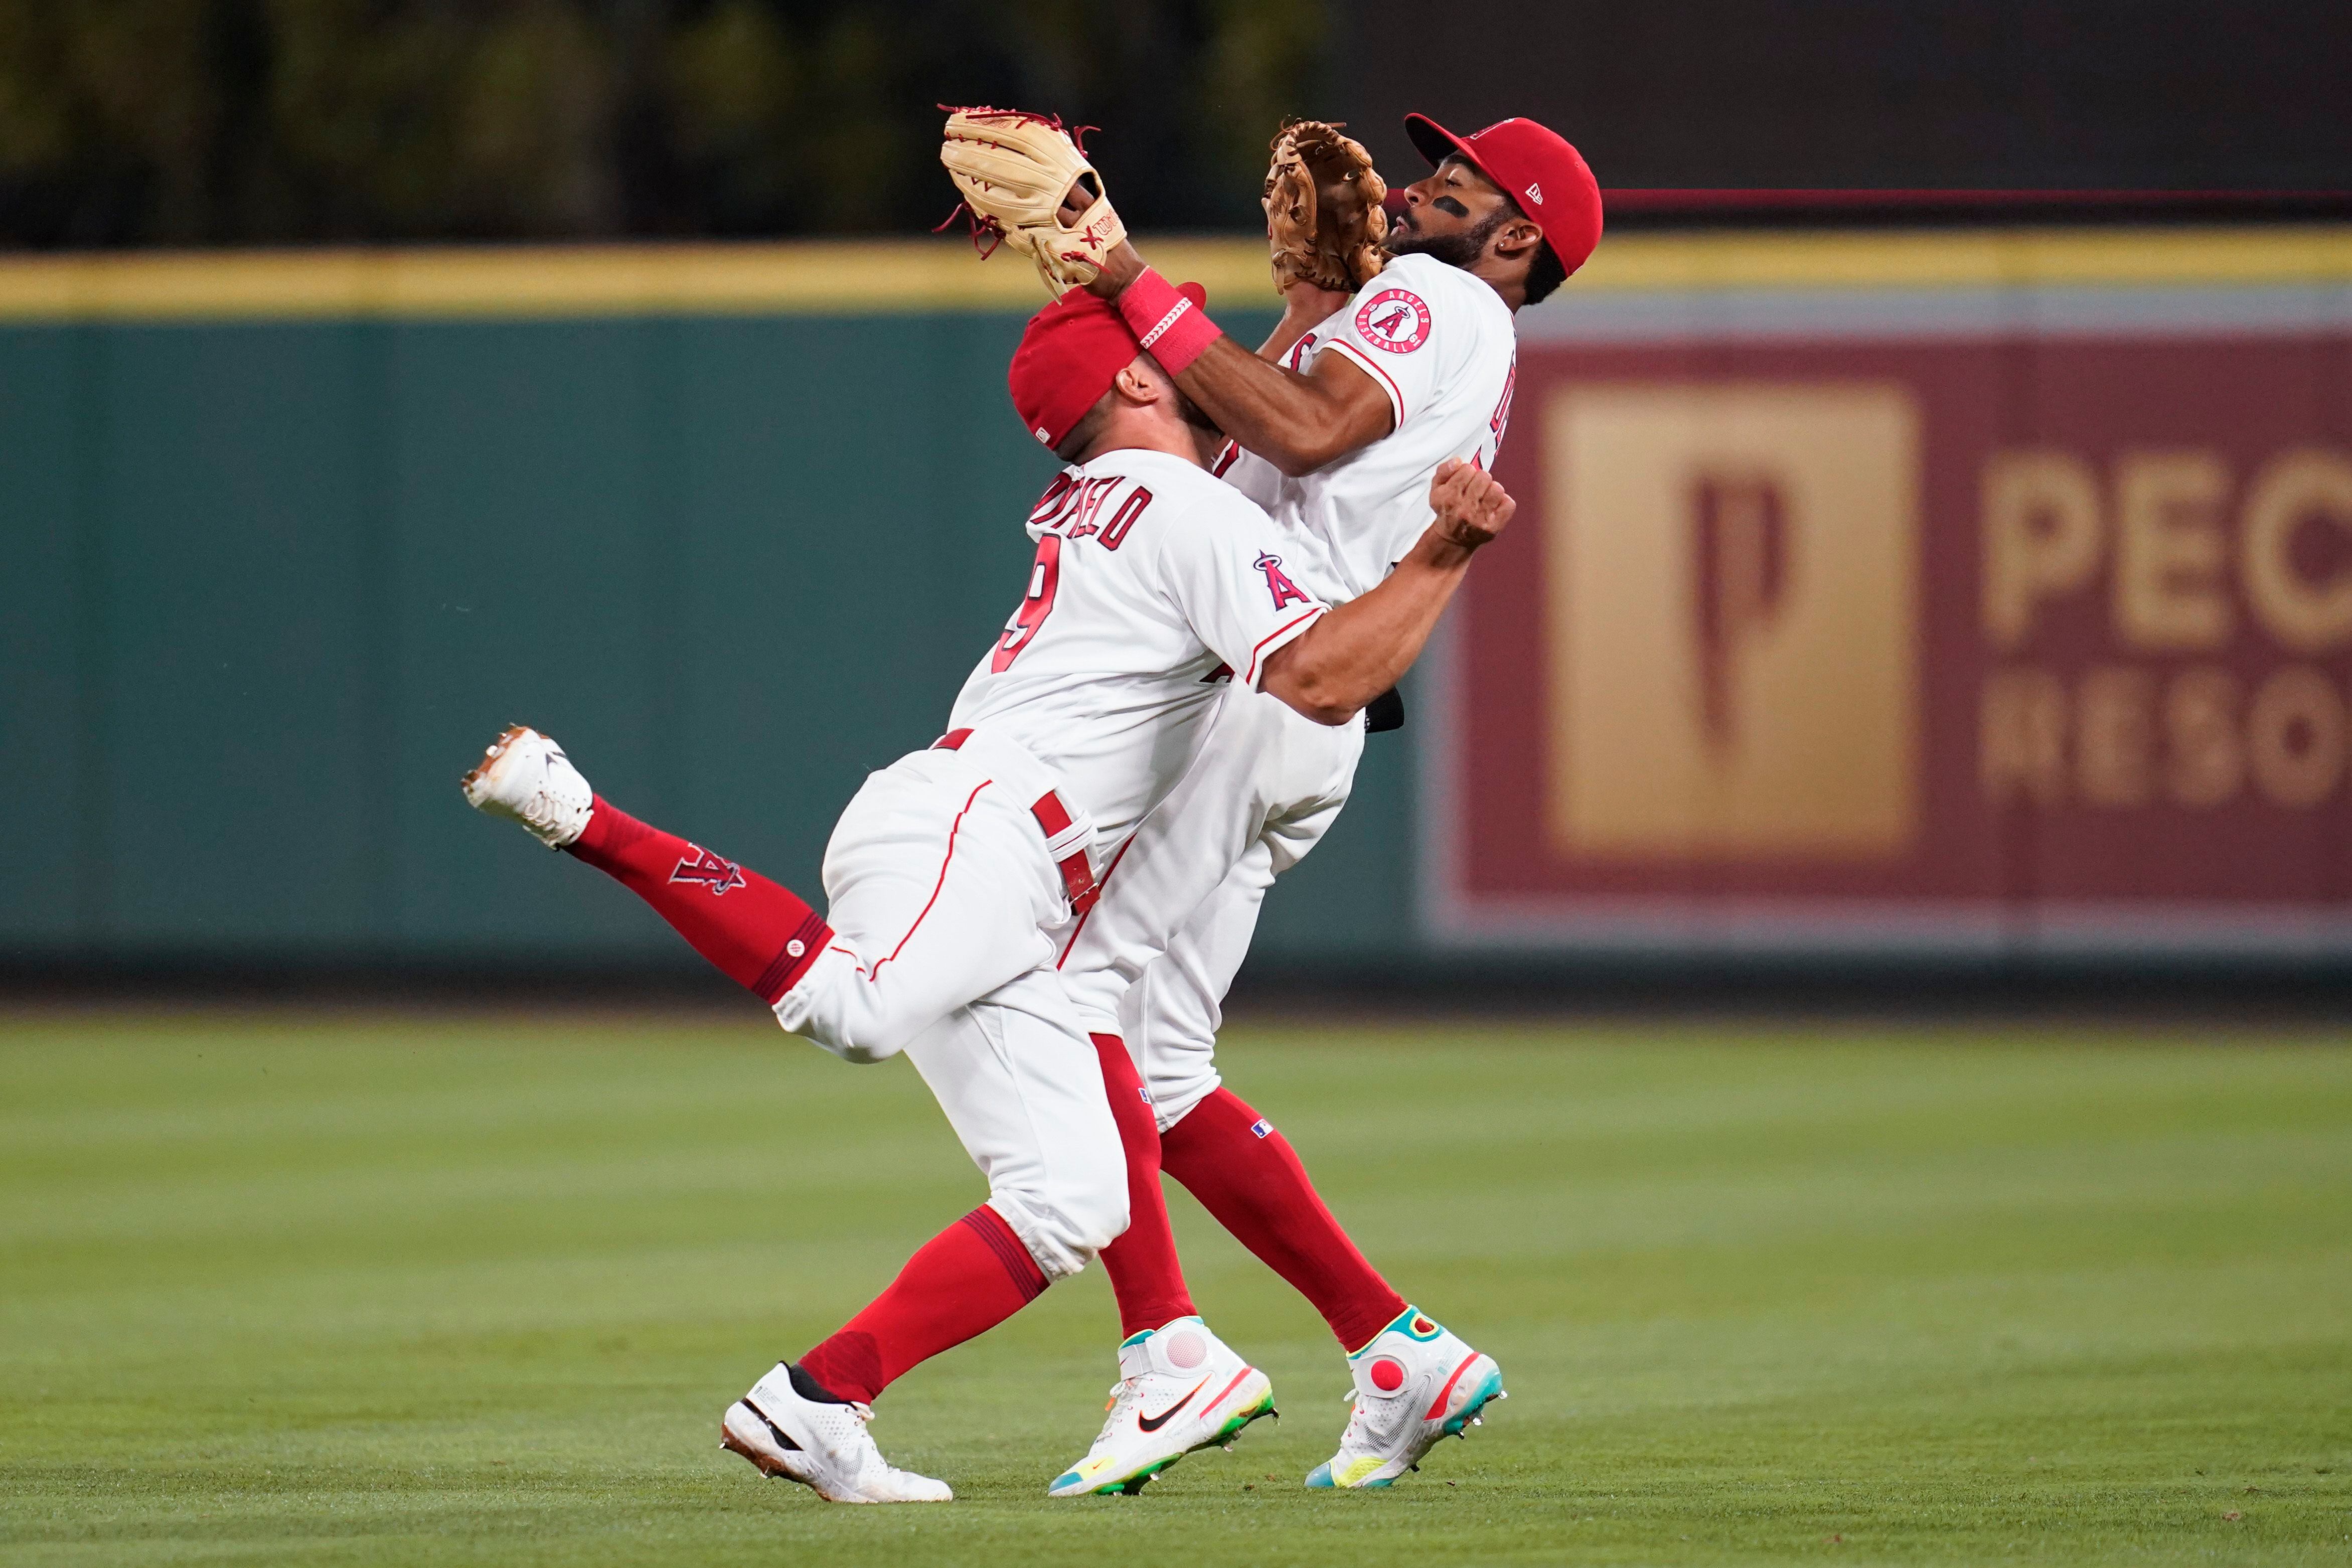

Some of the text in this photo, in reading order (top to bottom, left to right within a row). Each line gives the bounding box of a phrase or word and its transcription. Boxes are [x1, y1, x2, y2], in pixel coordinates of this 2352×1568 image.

[1389, 290, 1430, 323] ANGELS
[1357, 315, 1407, 352] BASEBALL
[1408, 334, 1422, 347] 61
[991, 533, 1061, 675] 9
